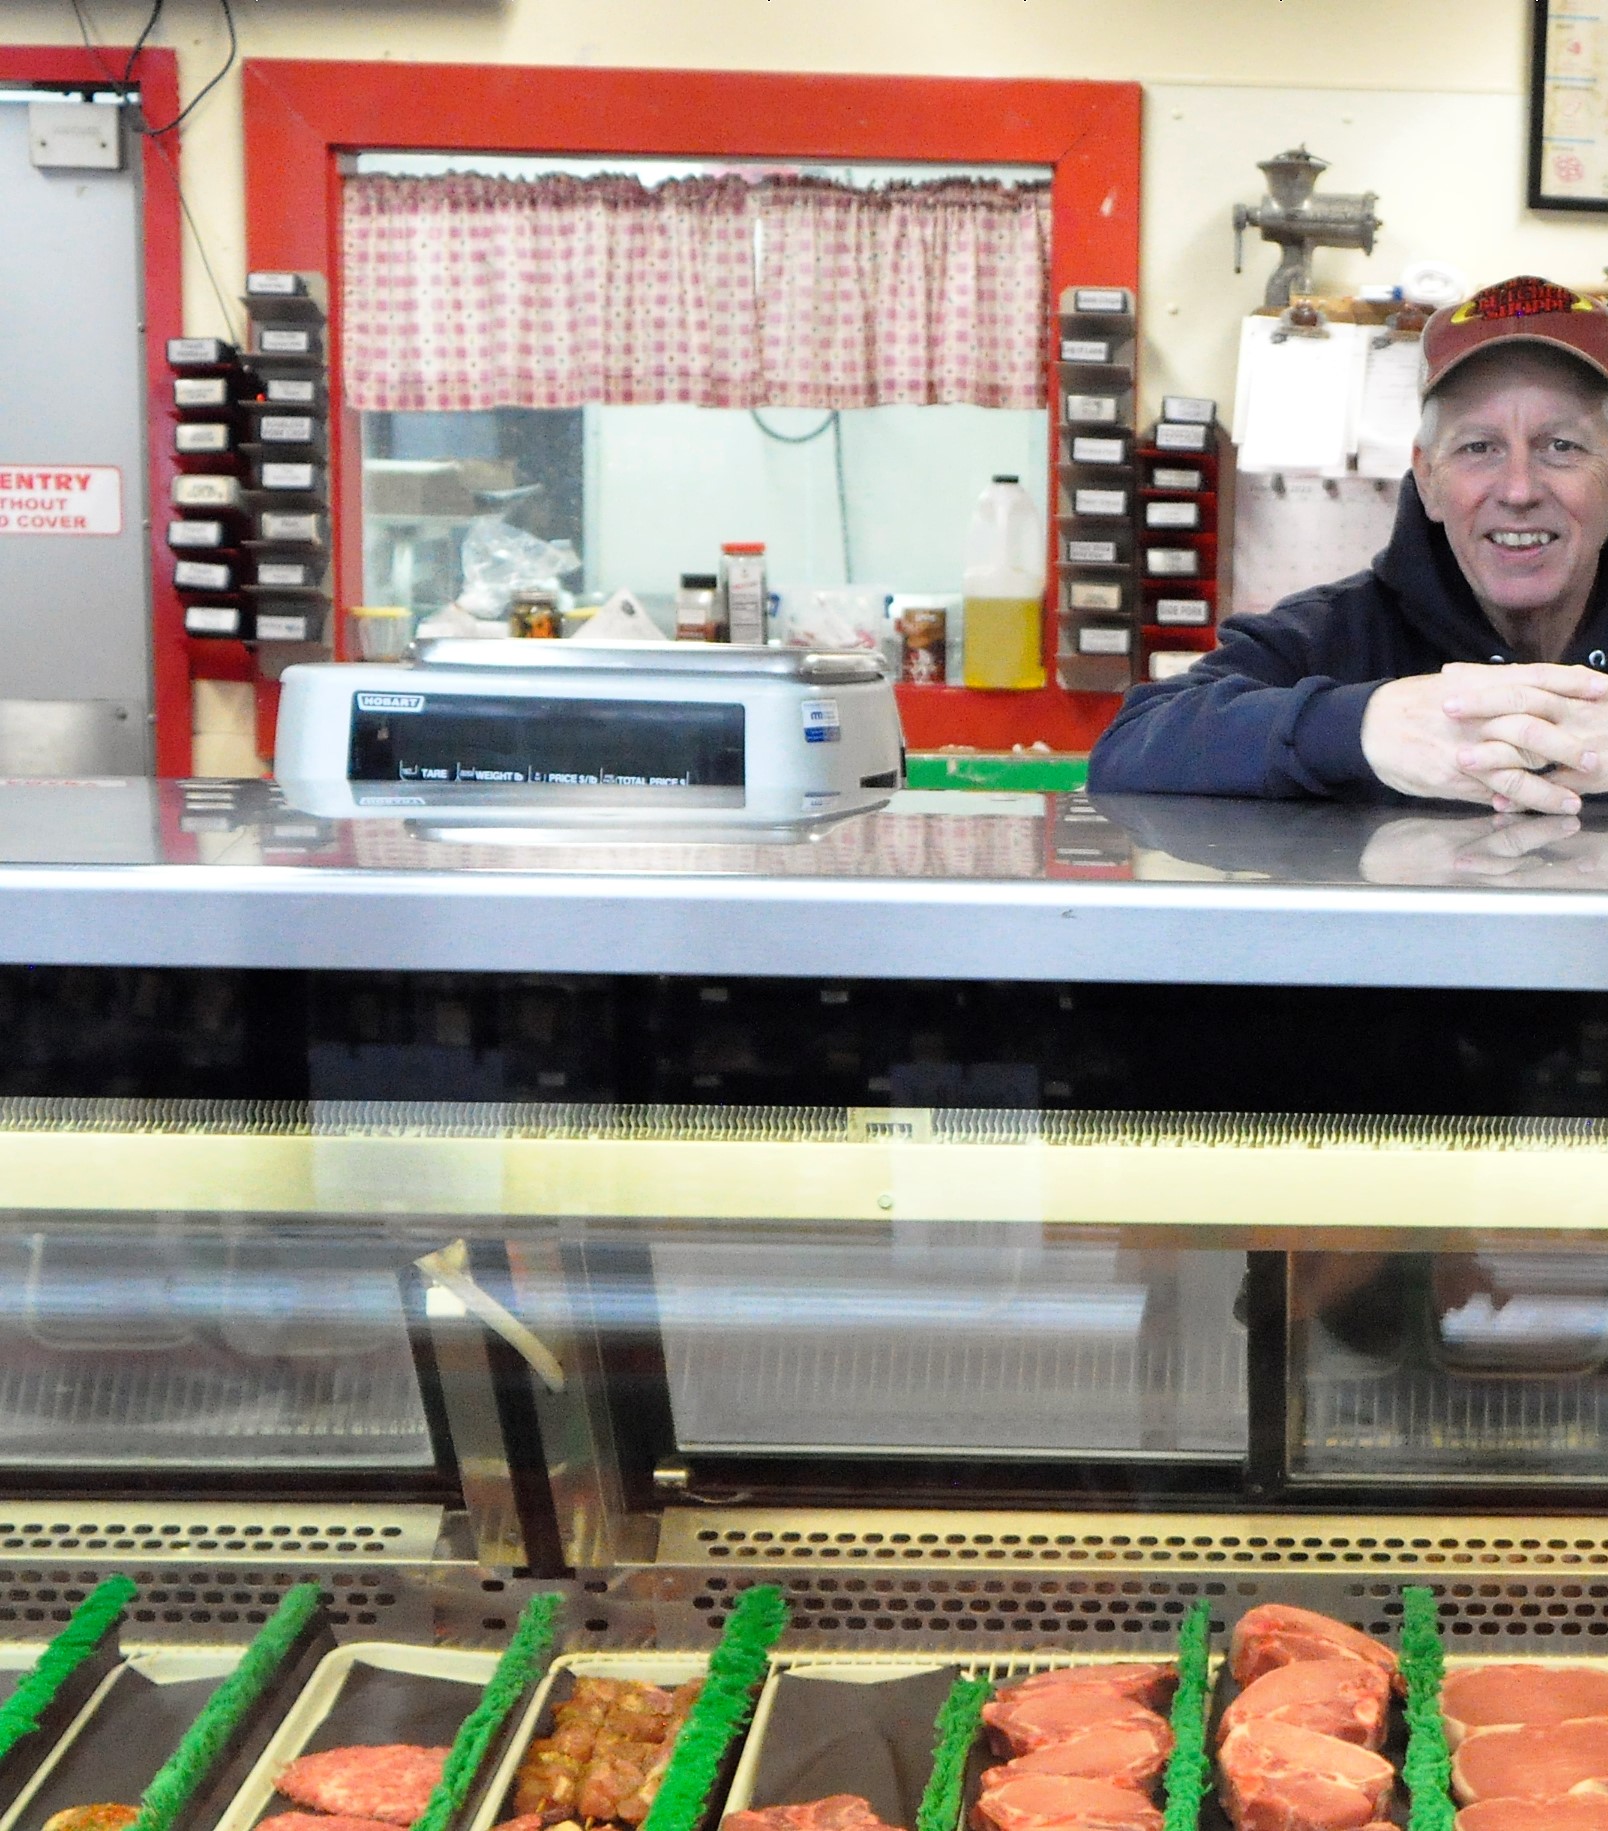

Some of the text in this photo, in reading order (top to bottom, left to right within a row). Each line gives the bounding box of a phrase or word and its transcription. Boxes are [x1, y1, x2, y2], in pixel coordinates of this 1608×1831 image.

[0, 473, 91, 490] ENTRY
[17, 515, 87, 528] COVER
[364, 696, 418, 707] HOBART
[421, 768, 448, 779] TARE
[475, 770, 513, 781] WEIGHT
[549, 773, 577, 784] PRICE
[617, 775, 647, 785] TOTAL
[649, 777, 677, 786] PRICE
